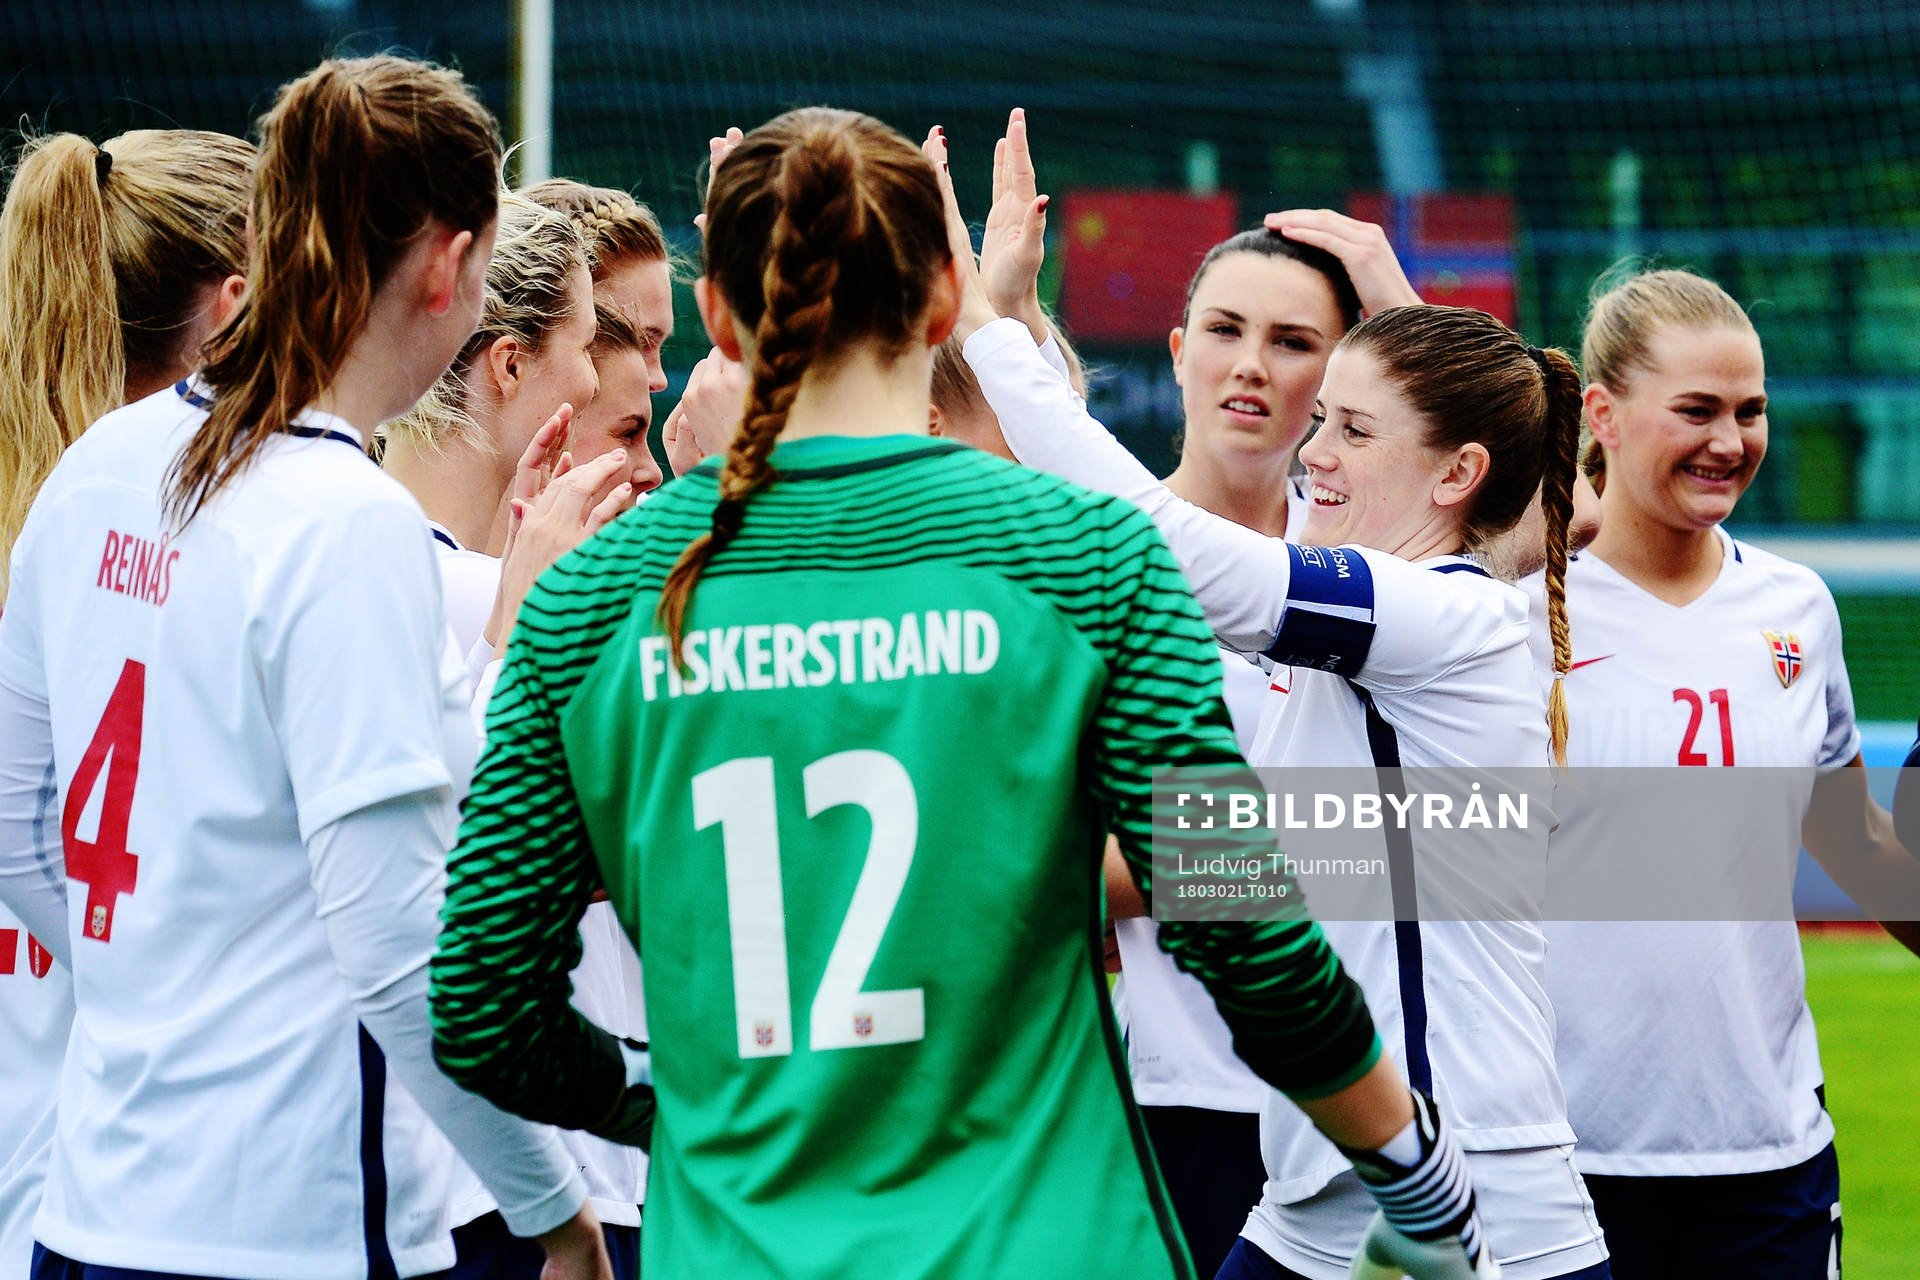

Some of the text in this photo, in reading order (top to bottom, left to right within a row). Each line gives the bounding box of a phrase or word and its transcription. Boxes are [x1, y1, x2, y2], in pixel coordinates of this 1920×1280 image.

[97, 529, 180, 607] REINÅS
[1327, 547, 1351, 578] CISM
[639, 610, 1001, 701] FISKERSTRAND
[1672, 687, 1735, 767] 21
[61, 657, 146, 943] 4
[691, 749, 926, 1059] 12
